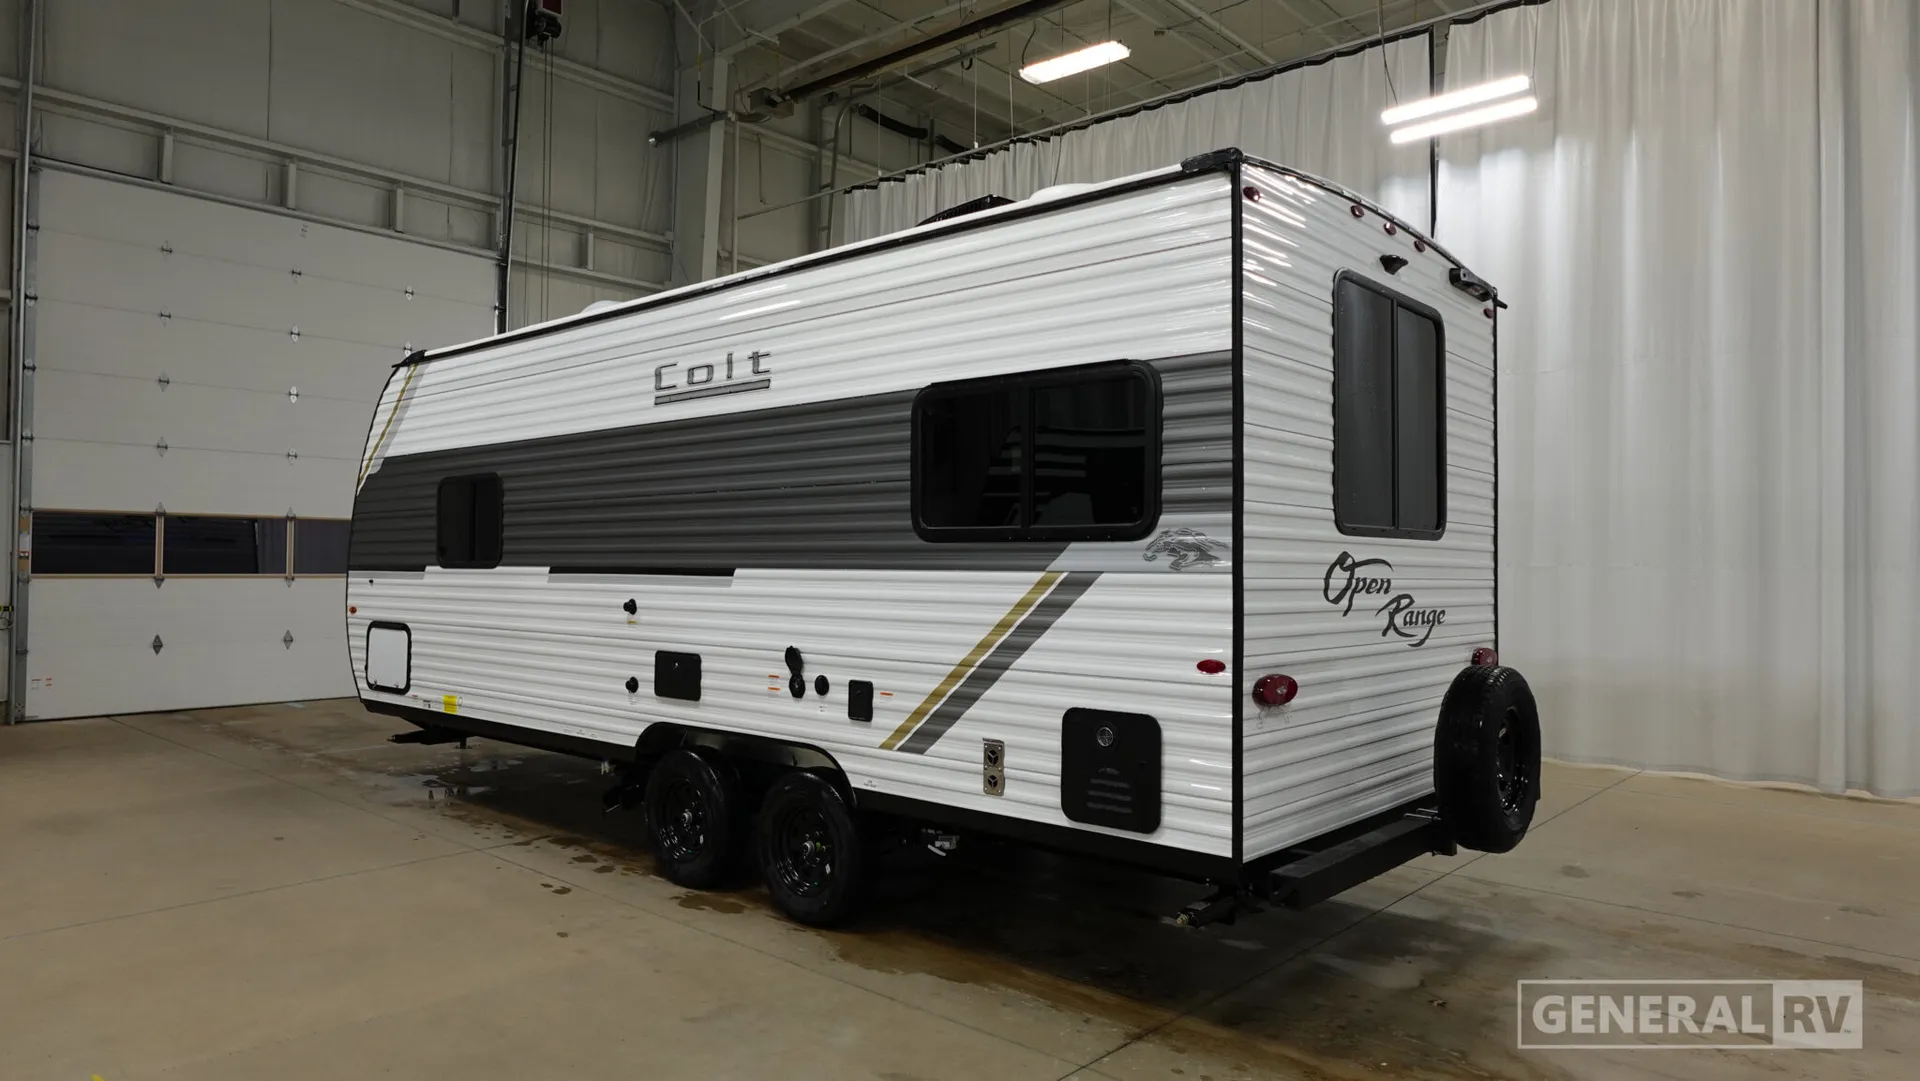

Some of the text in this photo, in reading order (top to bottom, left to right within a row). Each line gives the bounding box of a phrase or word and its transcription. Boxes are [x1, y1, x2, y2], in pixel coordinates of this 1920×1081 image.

[655, 351, 770, 390] Colt
[1323, 551, 1394, 617] Open
[1375, 593, 1446, 647] Range
